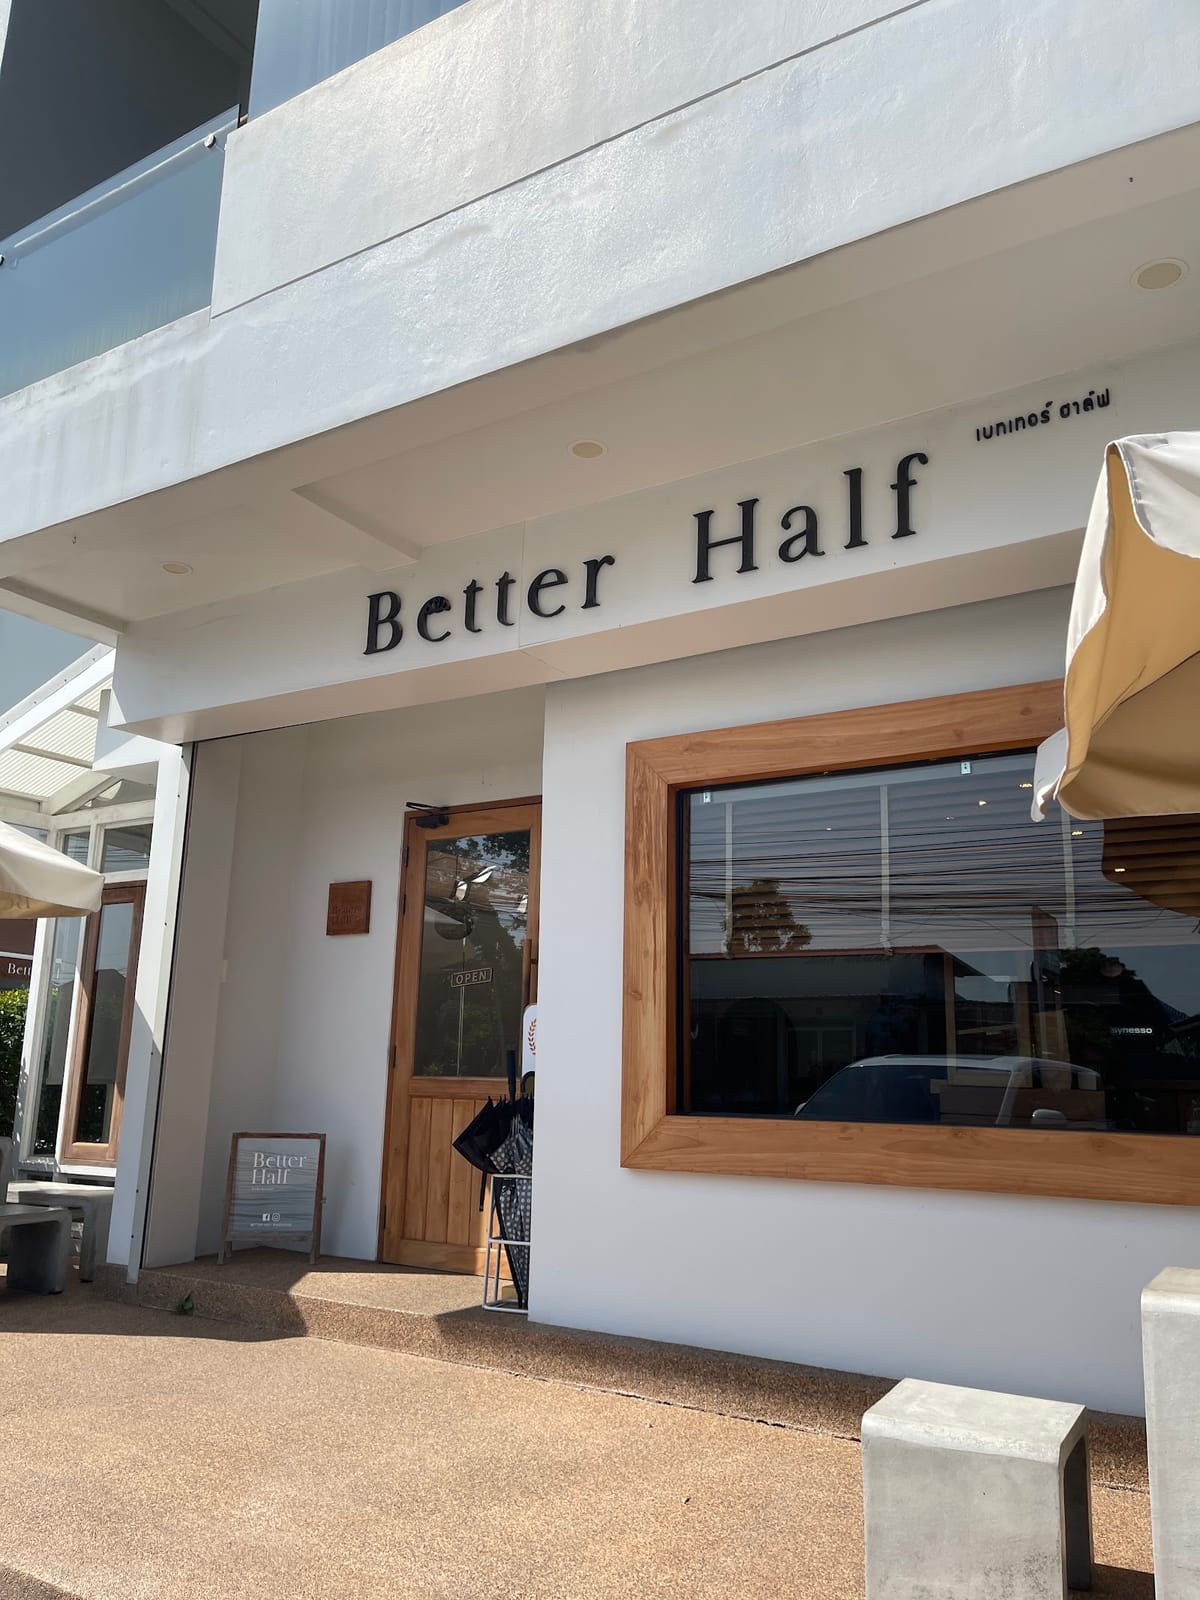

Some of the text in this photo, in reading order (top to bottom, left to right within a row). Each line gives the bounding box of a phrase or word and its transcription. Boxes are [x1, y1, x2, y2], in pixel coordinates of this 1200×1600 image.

[363, 451, 929, 655] Better Half
[455, 970, 488, 985] OPEN
[1111, 1027, 1153, 1036] synesso
[253, 1152, 308, 1168] Better
[251, 1168, 291, 1185] Half
